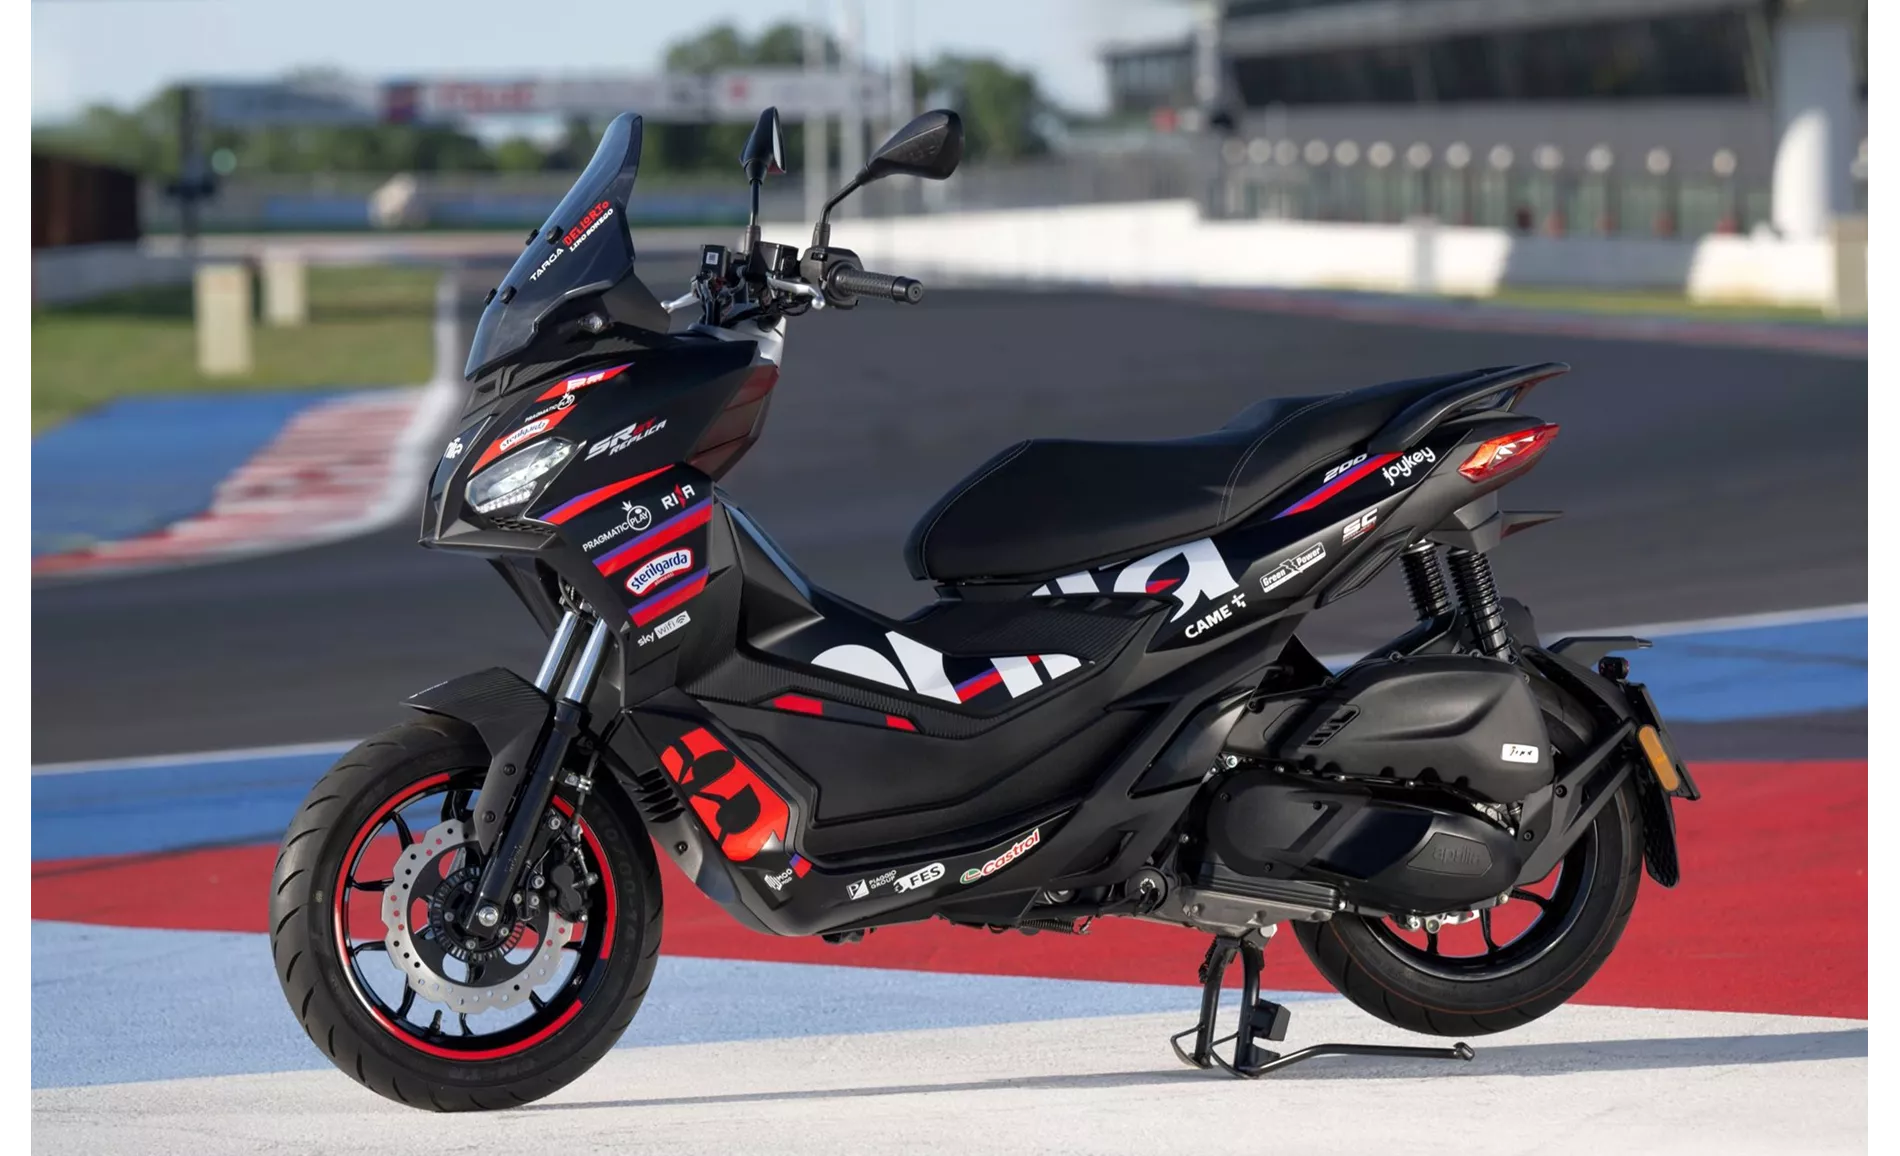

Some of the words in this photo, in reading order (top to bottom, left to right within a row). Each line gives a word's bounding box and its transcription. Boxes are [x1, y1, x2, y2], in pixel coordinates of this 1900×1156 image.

[529, 247, 564, 281] TARGA
[608, 419, 668, 457] REPLICA
[1323, 453, 1367, 484] 200
[1381, 446, 1436, 487] joykey
[582, 522, 630, 552] PRAGMATIC
[629, 511, 649, 527] PLAY
[1343, 508, 1378, 540] SC
[631, 552, 688, 590] sterilgarda
[1263, 569, 1286, 587] Green
[1297, 547, 1321, 566] Power
[637, 632, 655, 647] sky
[657, 620, 676, 635] wifi
[1184, 603, 1233, 639] CAME
[980, 828, 1041, 876] Castrol
[869, 870, 897, 886] PIAGGIO
[871, 875, 896, 890] GROUP
[910, 865, 941, 886] FES
